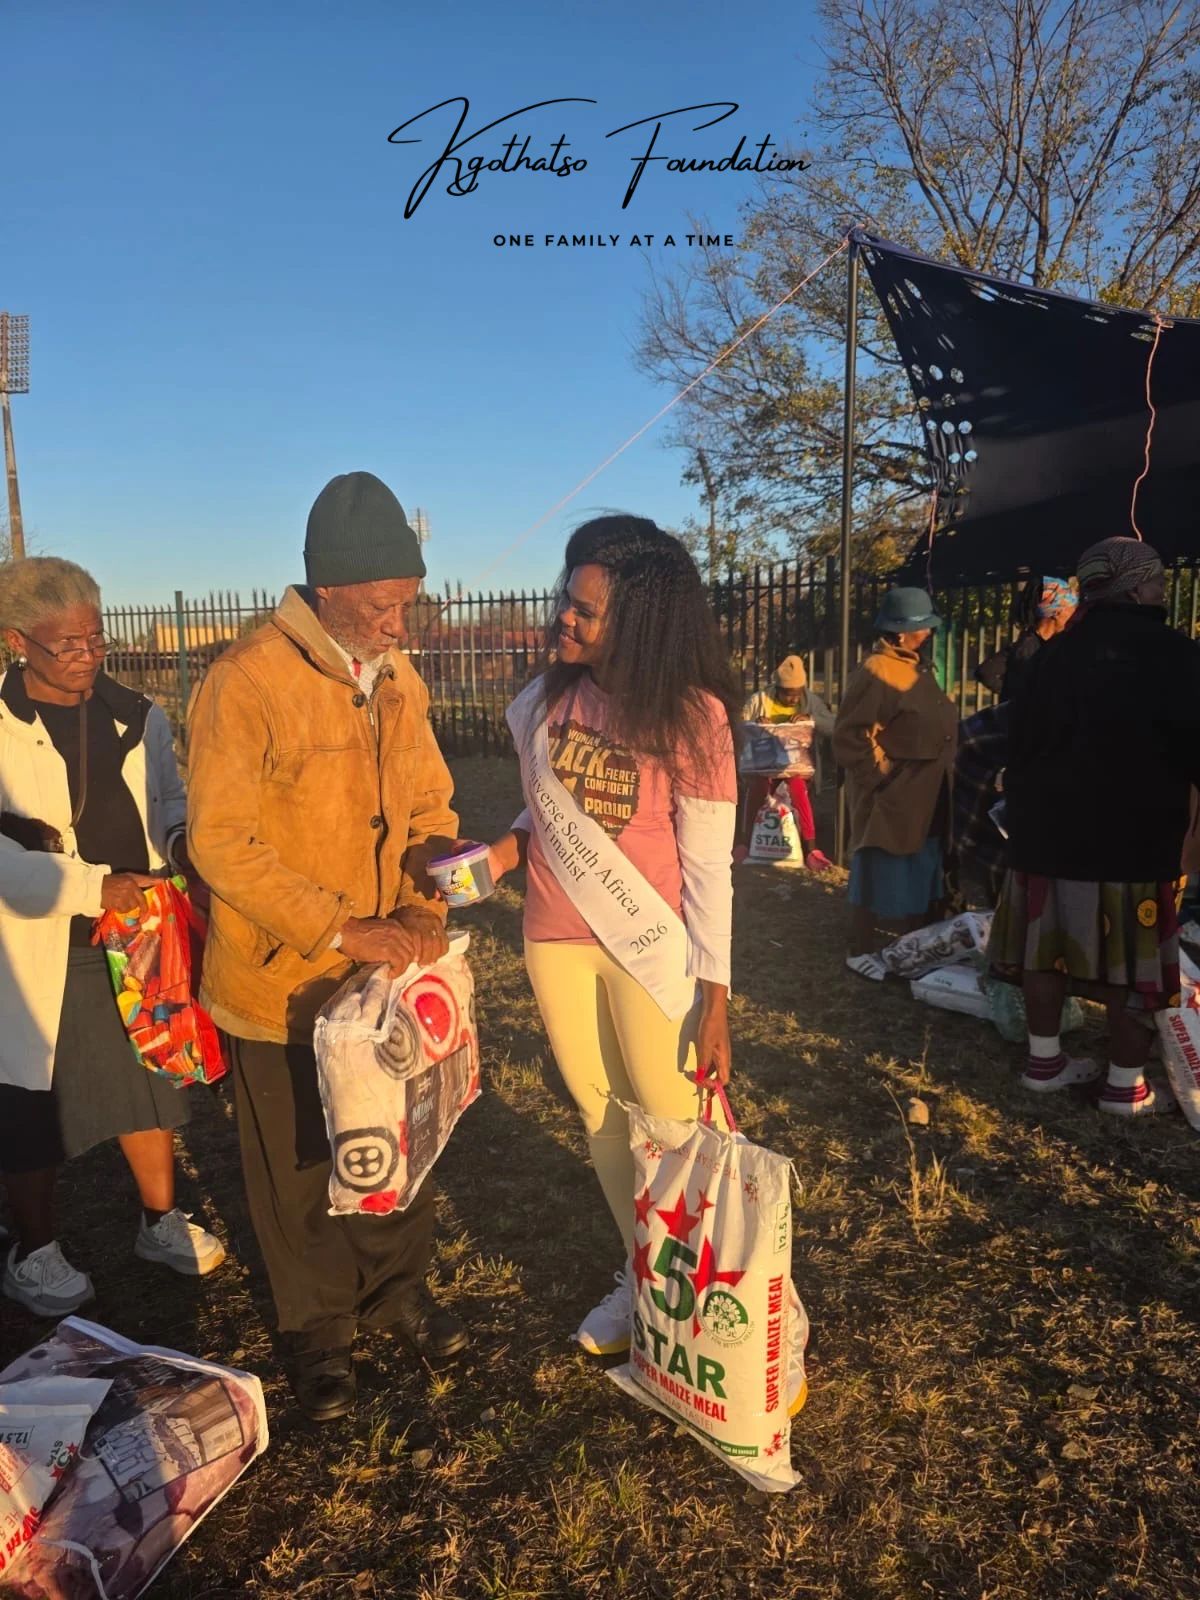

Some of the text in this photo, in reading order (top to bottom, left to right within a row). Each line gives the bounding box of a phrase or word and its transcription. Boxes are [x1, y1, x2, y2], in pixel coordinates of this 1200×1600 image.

[568, 729, 601, 748] WOMAN
[548, 738, 612, 779] LACK
[584, 777, 635, 796] CONFIDENT
[604, 768, 637, 784] FIERCE
[584, 797, 632, 820] PROUD
[763, 811, 780, 830] 5
[529, 754, 564, 823] Universe
[561, 821, 599, 868] South
[595, 863, 641, 917] Africa
[756, 833, 791, 848] STAR
[630, 920, 668, 955] 2026
[1169, 1015, 1191, 1044] SUPER
[650, 1236, 698, 1321] 5
[633, 1310, 728, 1399] STAR
[765, 1274, 783, 1413] SUPER MAIZE MEAL
[658, 1371, 692, 1406] MAIZE
[693, 1393, 728, 1423] MEAL
[6, 1431, 29, 1445] 12.5
